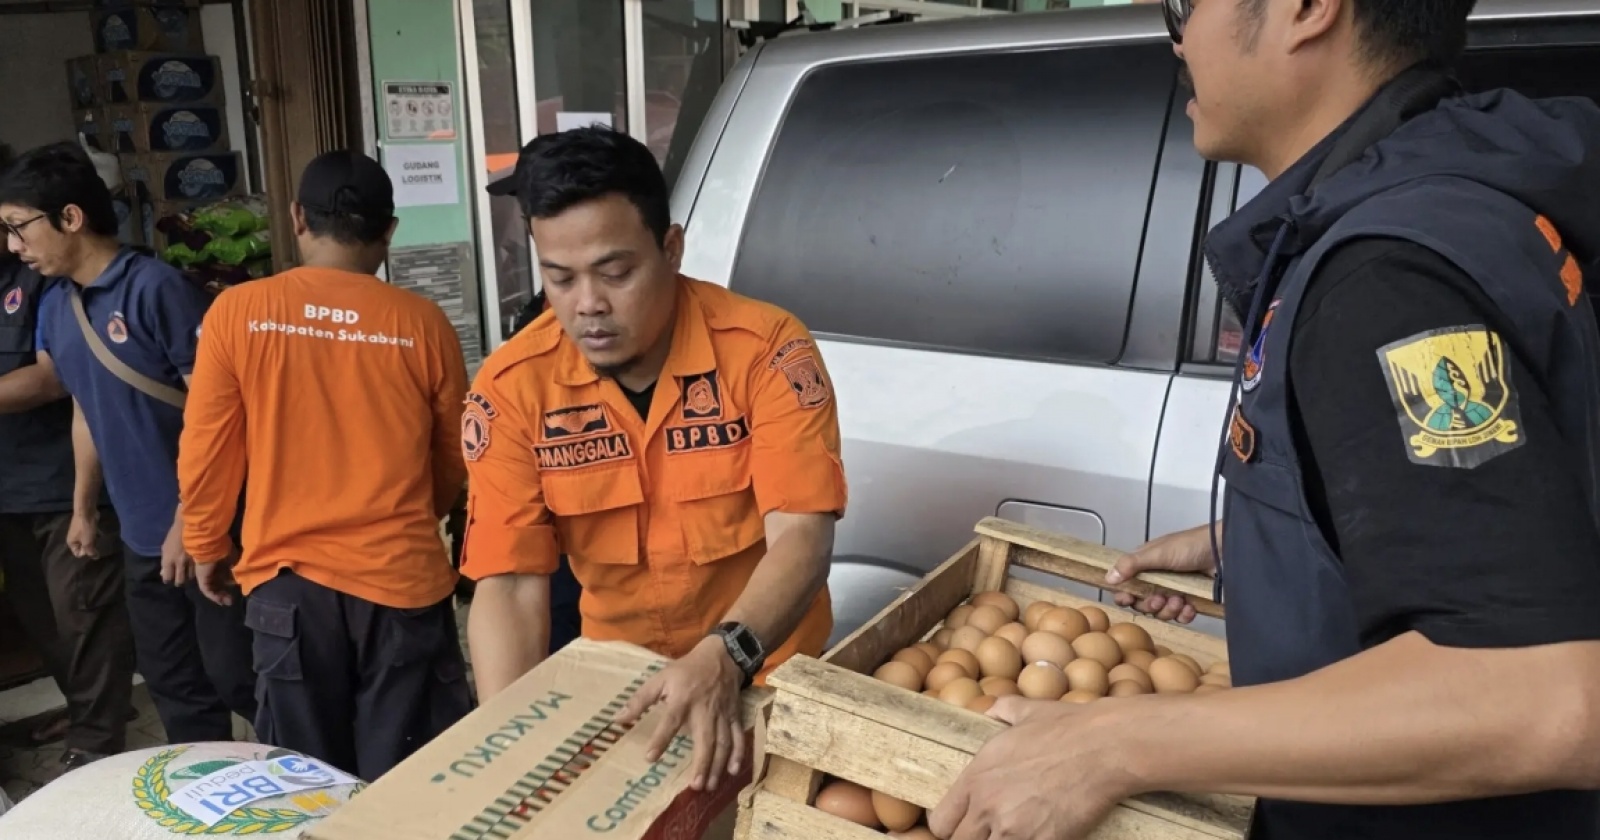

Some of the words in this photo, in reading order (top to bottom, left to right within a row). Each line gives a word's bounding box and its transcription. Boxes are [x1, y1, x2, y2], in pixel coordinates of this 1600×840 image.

[401, 174, 443, 184] LOGISTIK
[403, 161, 440, 171] GUDANG
[304, 304, 360, 324] BPBD
[248, 319, 334, 340] Kabupaten
[337, 328, 414, 348] Sukabumi
[539, 435, 627, 467] MANGGALA
[672, 423, 742, 449] BPBD
[449, 690, 573, 778] MAKUKU
[183, 763, 257, 801] peduli
[199, 775, 284, 816] BRI
[586, 757, 678, 834] Comfort
